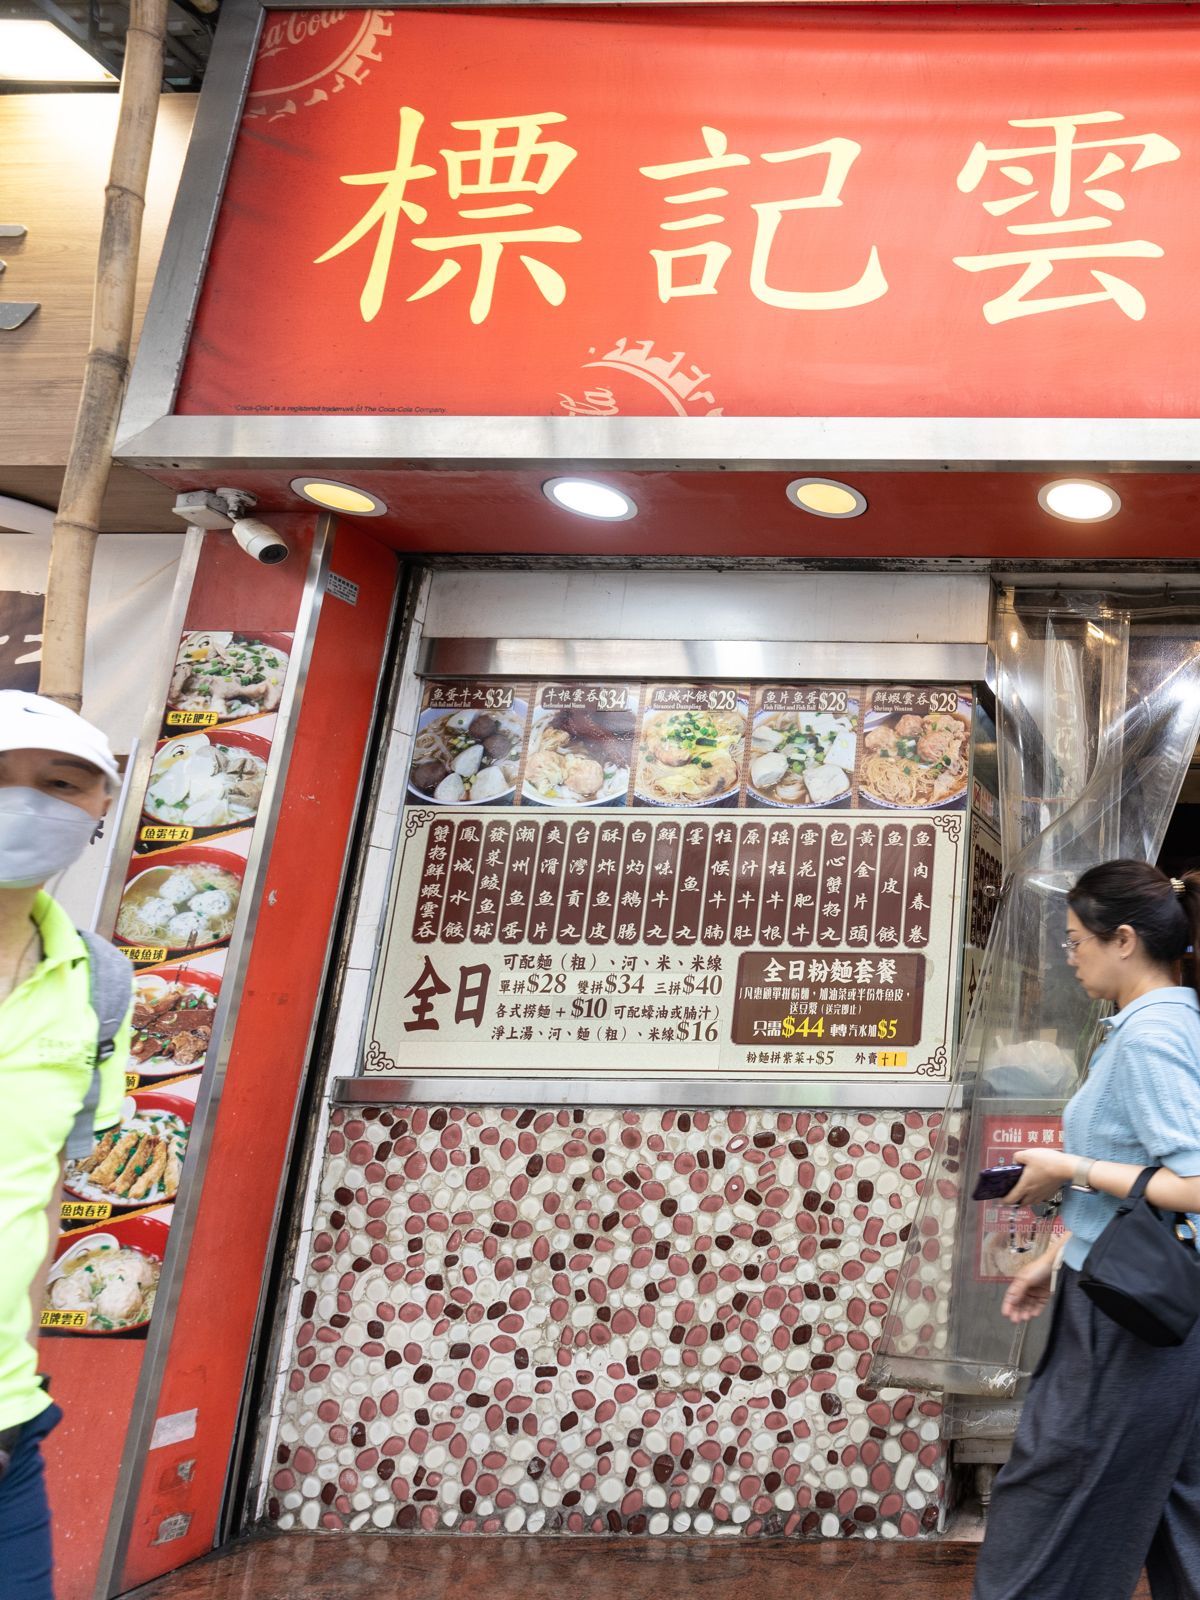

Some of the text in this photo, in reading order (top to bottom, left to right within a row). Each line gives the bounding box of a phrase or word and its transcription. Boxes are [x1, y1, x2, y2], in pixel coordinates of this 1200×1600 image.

[170, 712, 215, 724] 雪花肥牛
[431, 687, 513, 709] 魚蛋牛丸 $34
[598, 688, 627, 710] $34
[655, 689, 737, 710] 鳳城水餃 $28
[763, 691, 847, 712] 魚片魚蛋 $28
[873, 691, 958, 712] 鮮蝦雲吞 $28
[144, 828, 190, 840] 魚蛋牛丸
[443, 826, 480, 938] 鳳城水餃
[473, 827, 509, 938] 發菜鯪魚球
[502, 827, 535, 940] 潮州魚蛋
[531, 827, 564, 940] 爽滑魚片
[559, 827, 591, 939] 台灣貢丸
[588, 828, 621, 940] 酥炸魚皮
[617, 828, 647, 940] 白灼鵝腸
[646, 828, 677, 940] 鮮味牛丸
[675, 828, 705, 940] 墨魚丸
[733, 829, 761, 940] 原汁牛肚
[792, 829, 819, 941] 雪花肥牛
[849, 829, 877, 943] 黃金片頭
[876, 831, 905, 943] 魚皮餃
[404, 955, 492, 1032] 全日
[763, 957, 898, 984] 全日粉麵套餐
